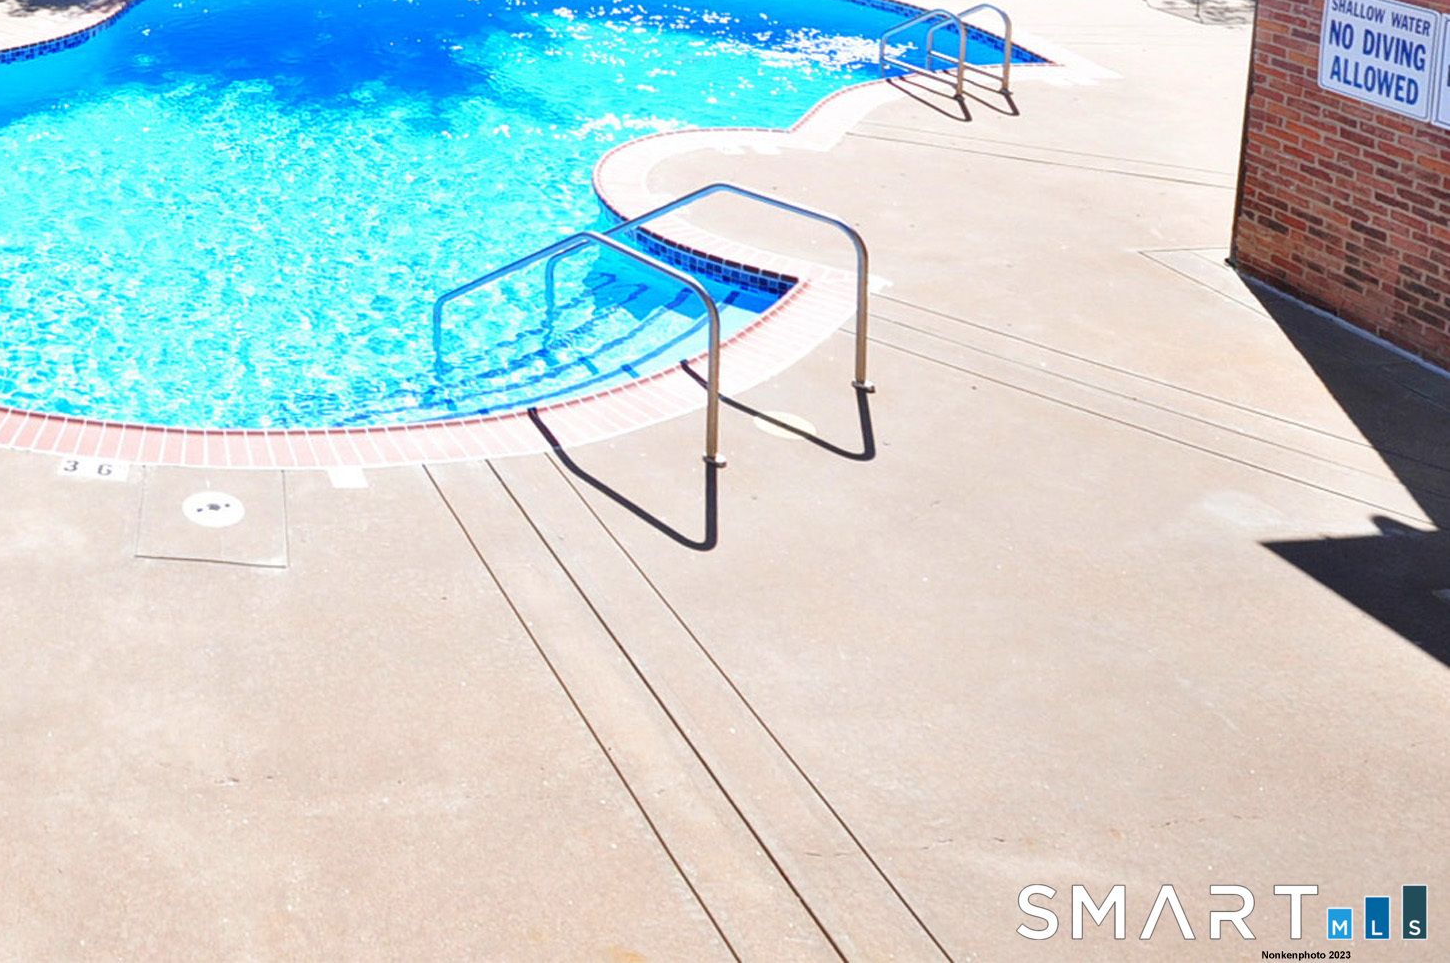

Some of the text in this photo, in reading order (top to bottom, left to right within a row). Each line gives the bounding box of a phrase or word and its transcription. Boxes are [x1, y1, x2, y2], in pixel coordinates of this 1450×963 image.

[1329, 19, 1426, 72] NO DIVING
[1391, 11, 1431, 36] WATER
[1329, 55, 1419, 105] ALLOWED
